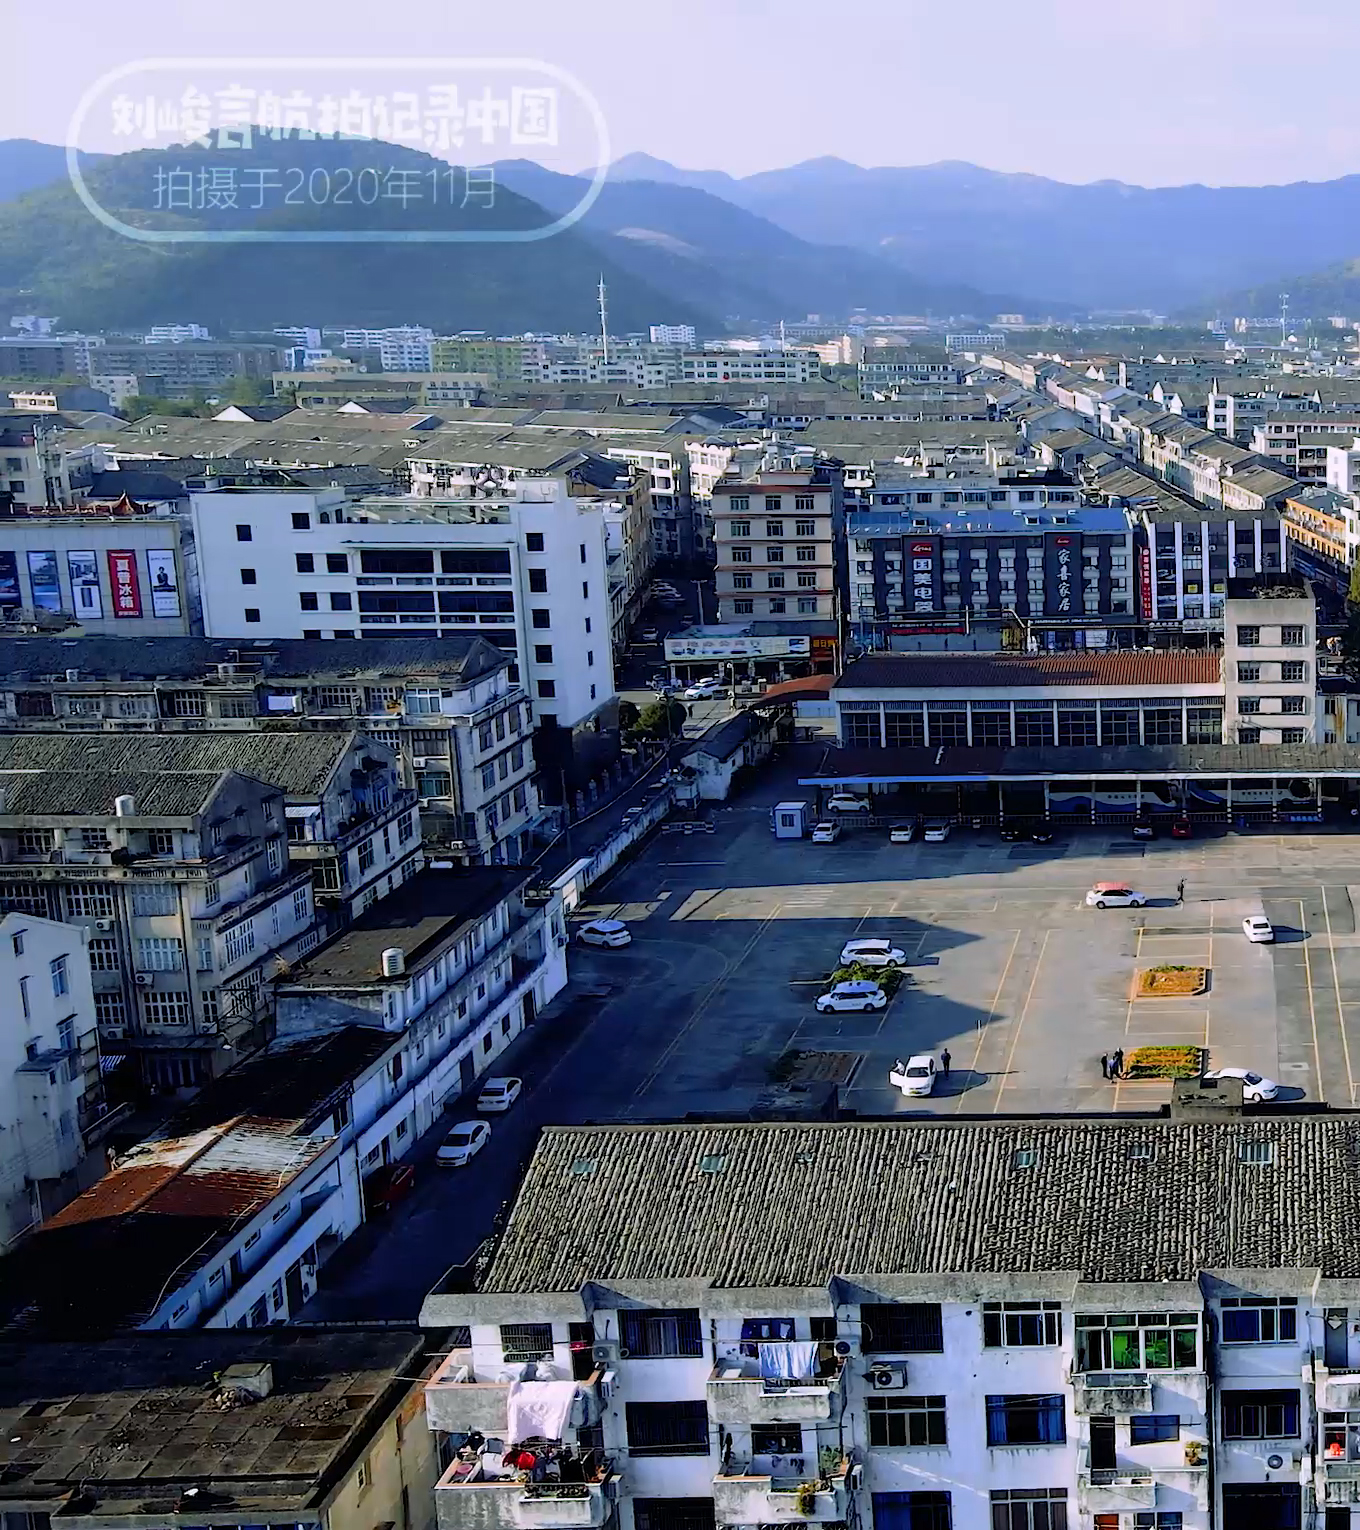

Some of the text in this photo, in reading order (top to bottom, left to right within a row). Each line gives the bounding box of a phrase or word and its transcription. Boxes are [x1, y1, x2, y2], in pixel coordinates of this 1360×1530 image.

[913, 558, 933, 613] 国美电器
[1056, 548, 1072, 612] 家喜家居
